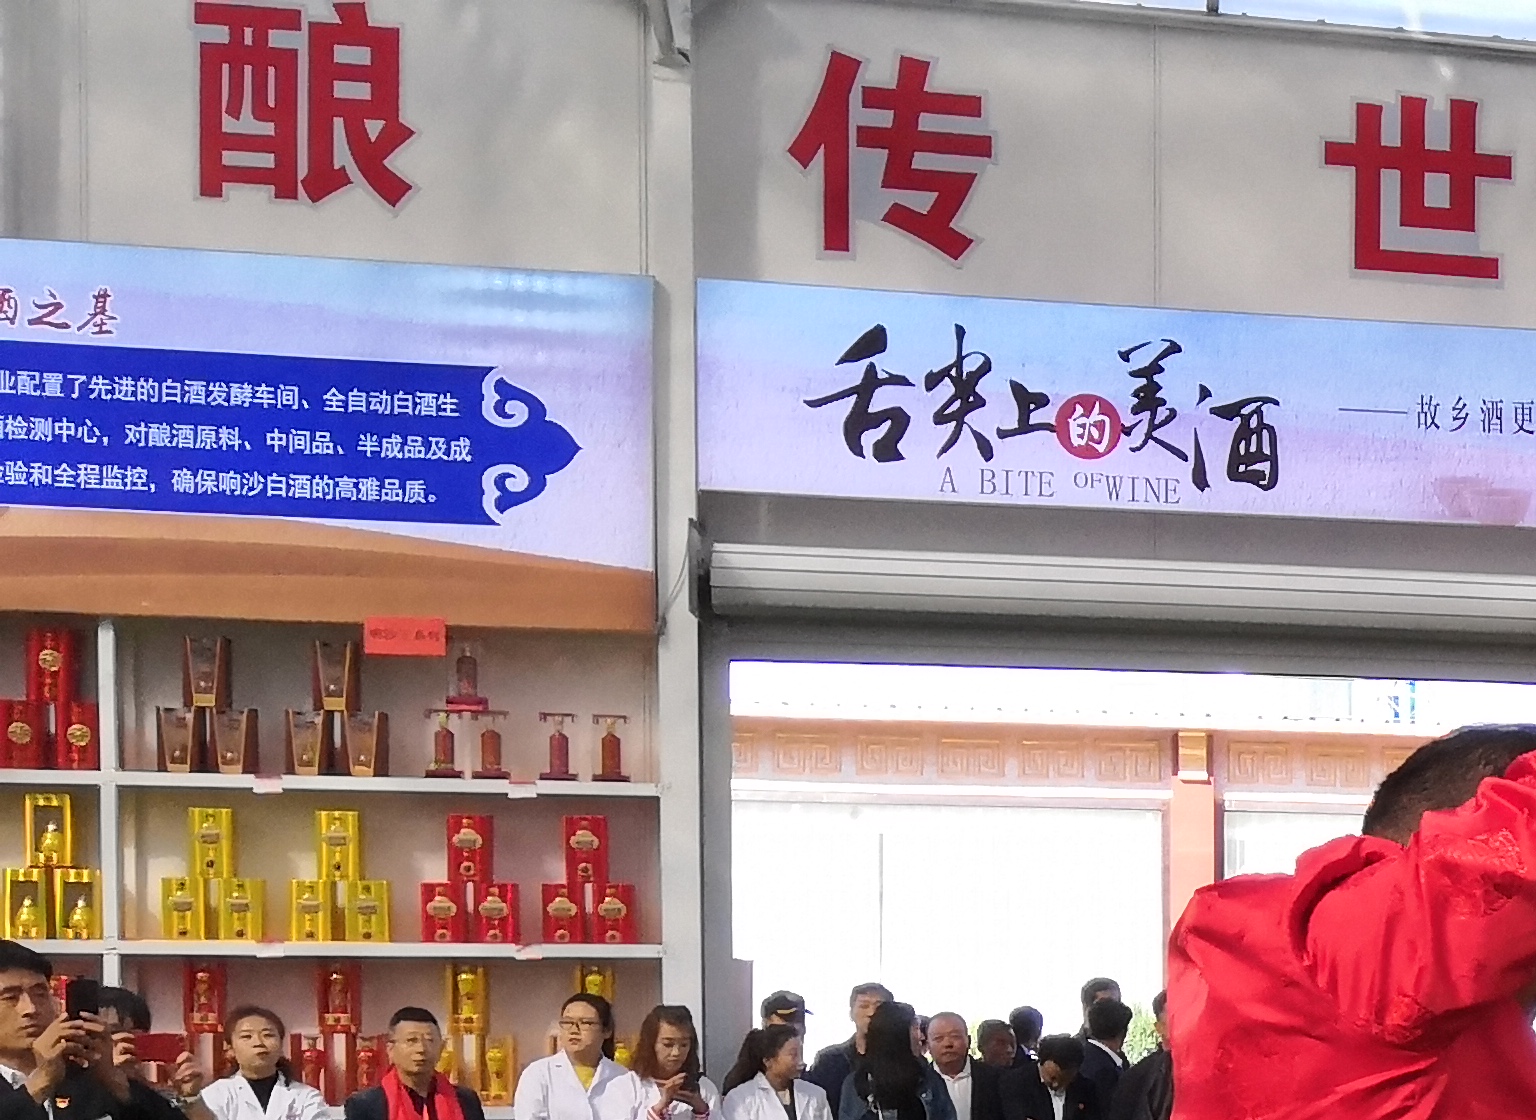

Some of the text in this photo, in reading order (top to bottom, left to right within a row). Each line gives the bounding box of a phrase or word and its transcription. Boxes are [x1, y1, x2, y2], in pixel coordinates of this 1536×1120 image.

[194, 1, 416, 208] 酿
[787, 49, 993, 262] 传
[1322, 95, 1513, 280] 世
[804, 324, 1282, 492] 舌尖上的美酒
[0, 414, 472, 462] 检测中心，对酿酒原料、中间品、半成品及成
[0, 460, 437, 503] 验和全程监控，确保响沙白酒的高雅品质。
[938, 466, 1181, 505] A BITE OF WINE
